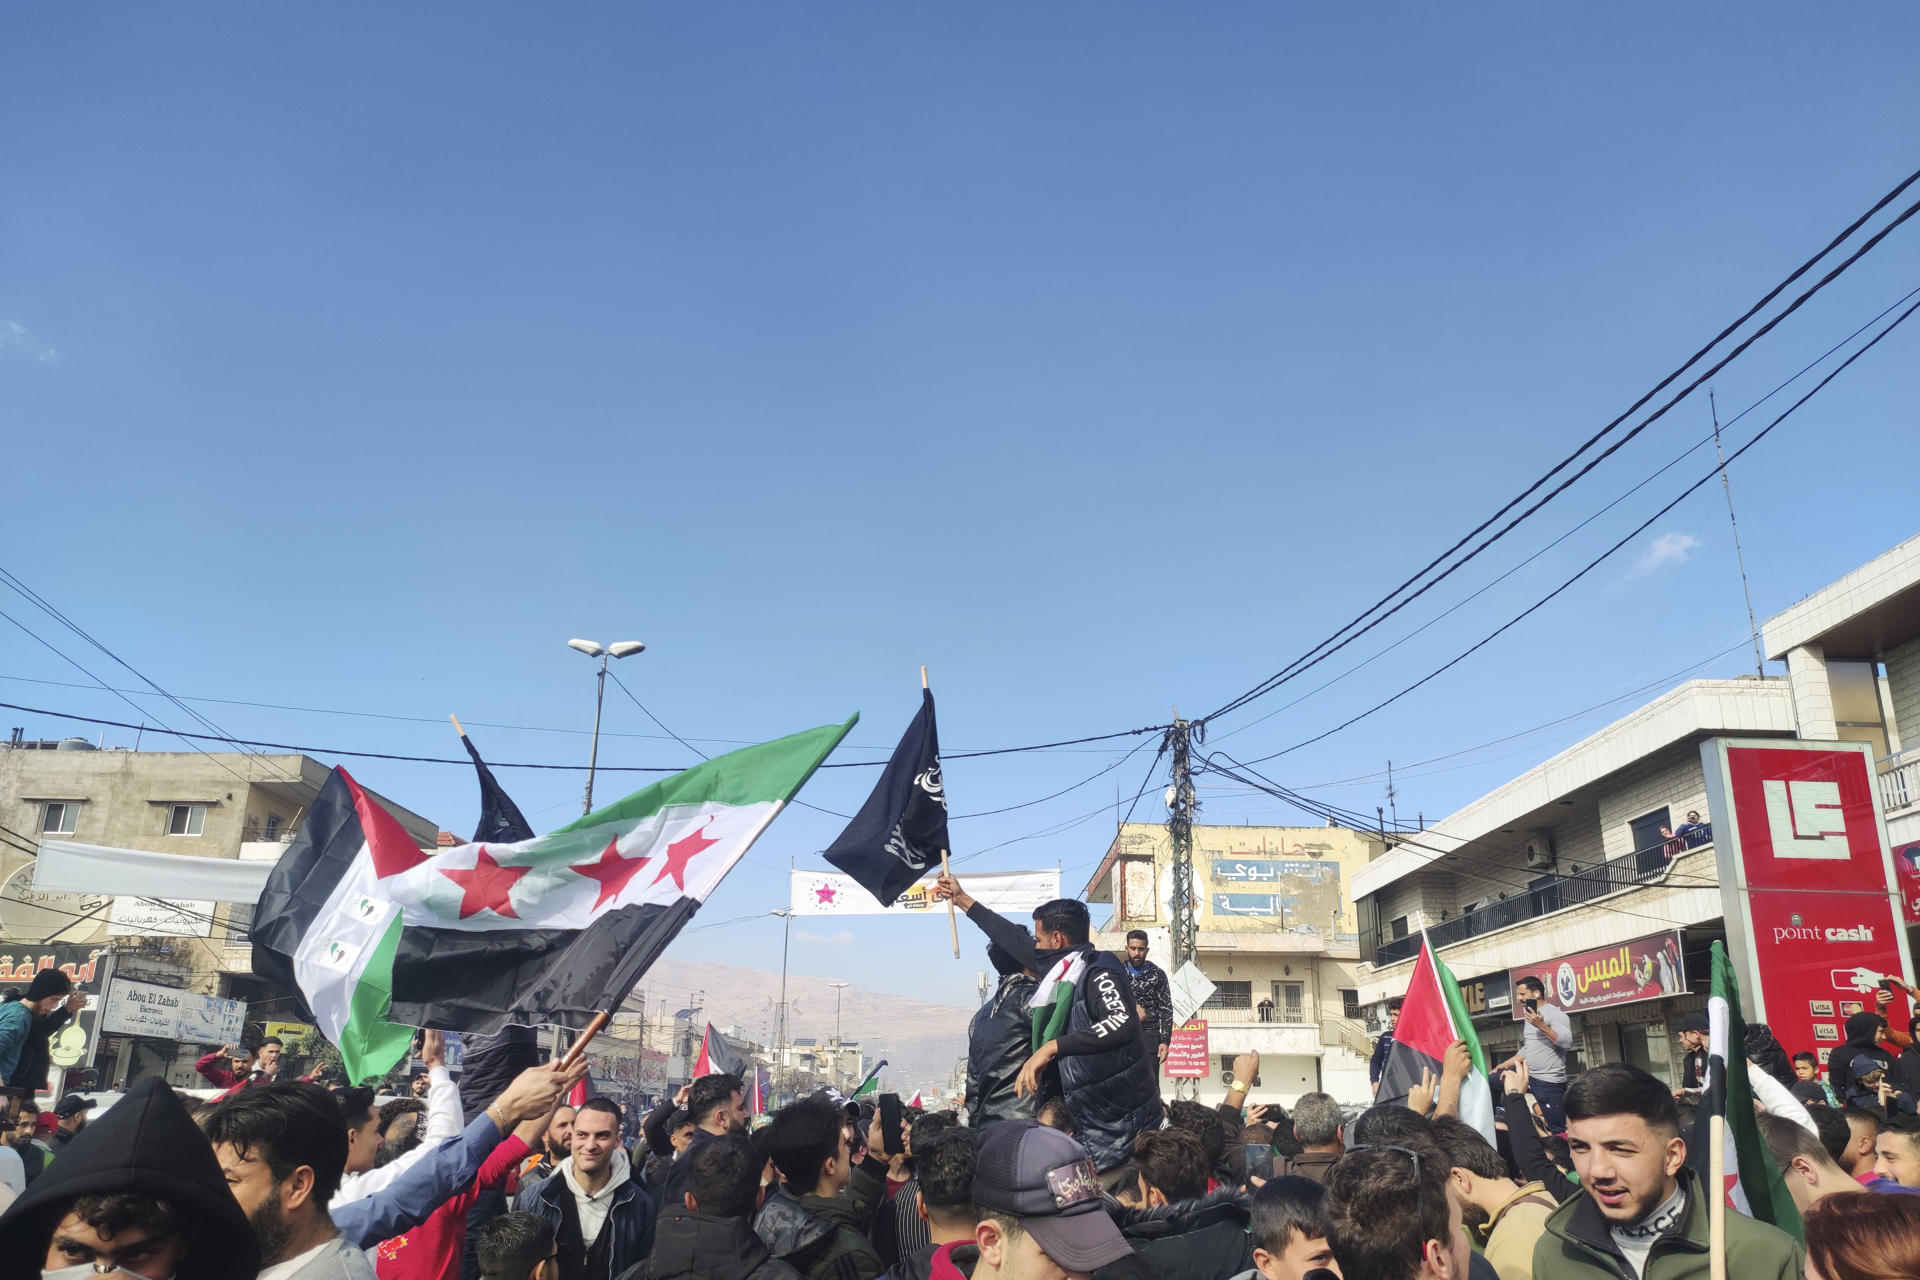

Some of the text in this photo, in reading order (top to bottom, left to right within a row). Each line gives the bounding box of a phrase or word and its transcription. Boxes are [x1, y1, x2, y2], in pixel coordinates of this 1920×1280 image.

[1773, 924, 1873, 945] point cash
[1576, 947, 1631, 994] الميس
[126, 989, 179, 1008] Abou El Zahab
[139, 1004, 163, 1016] Electronics
